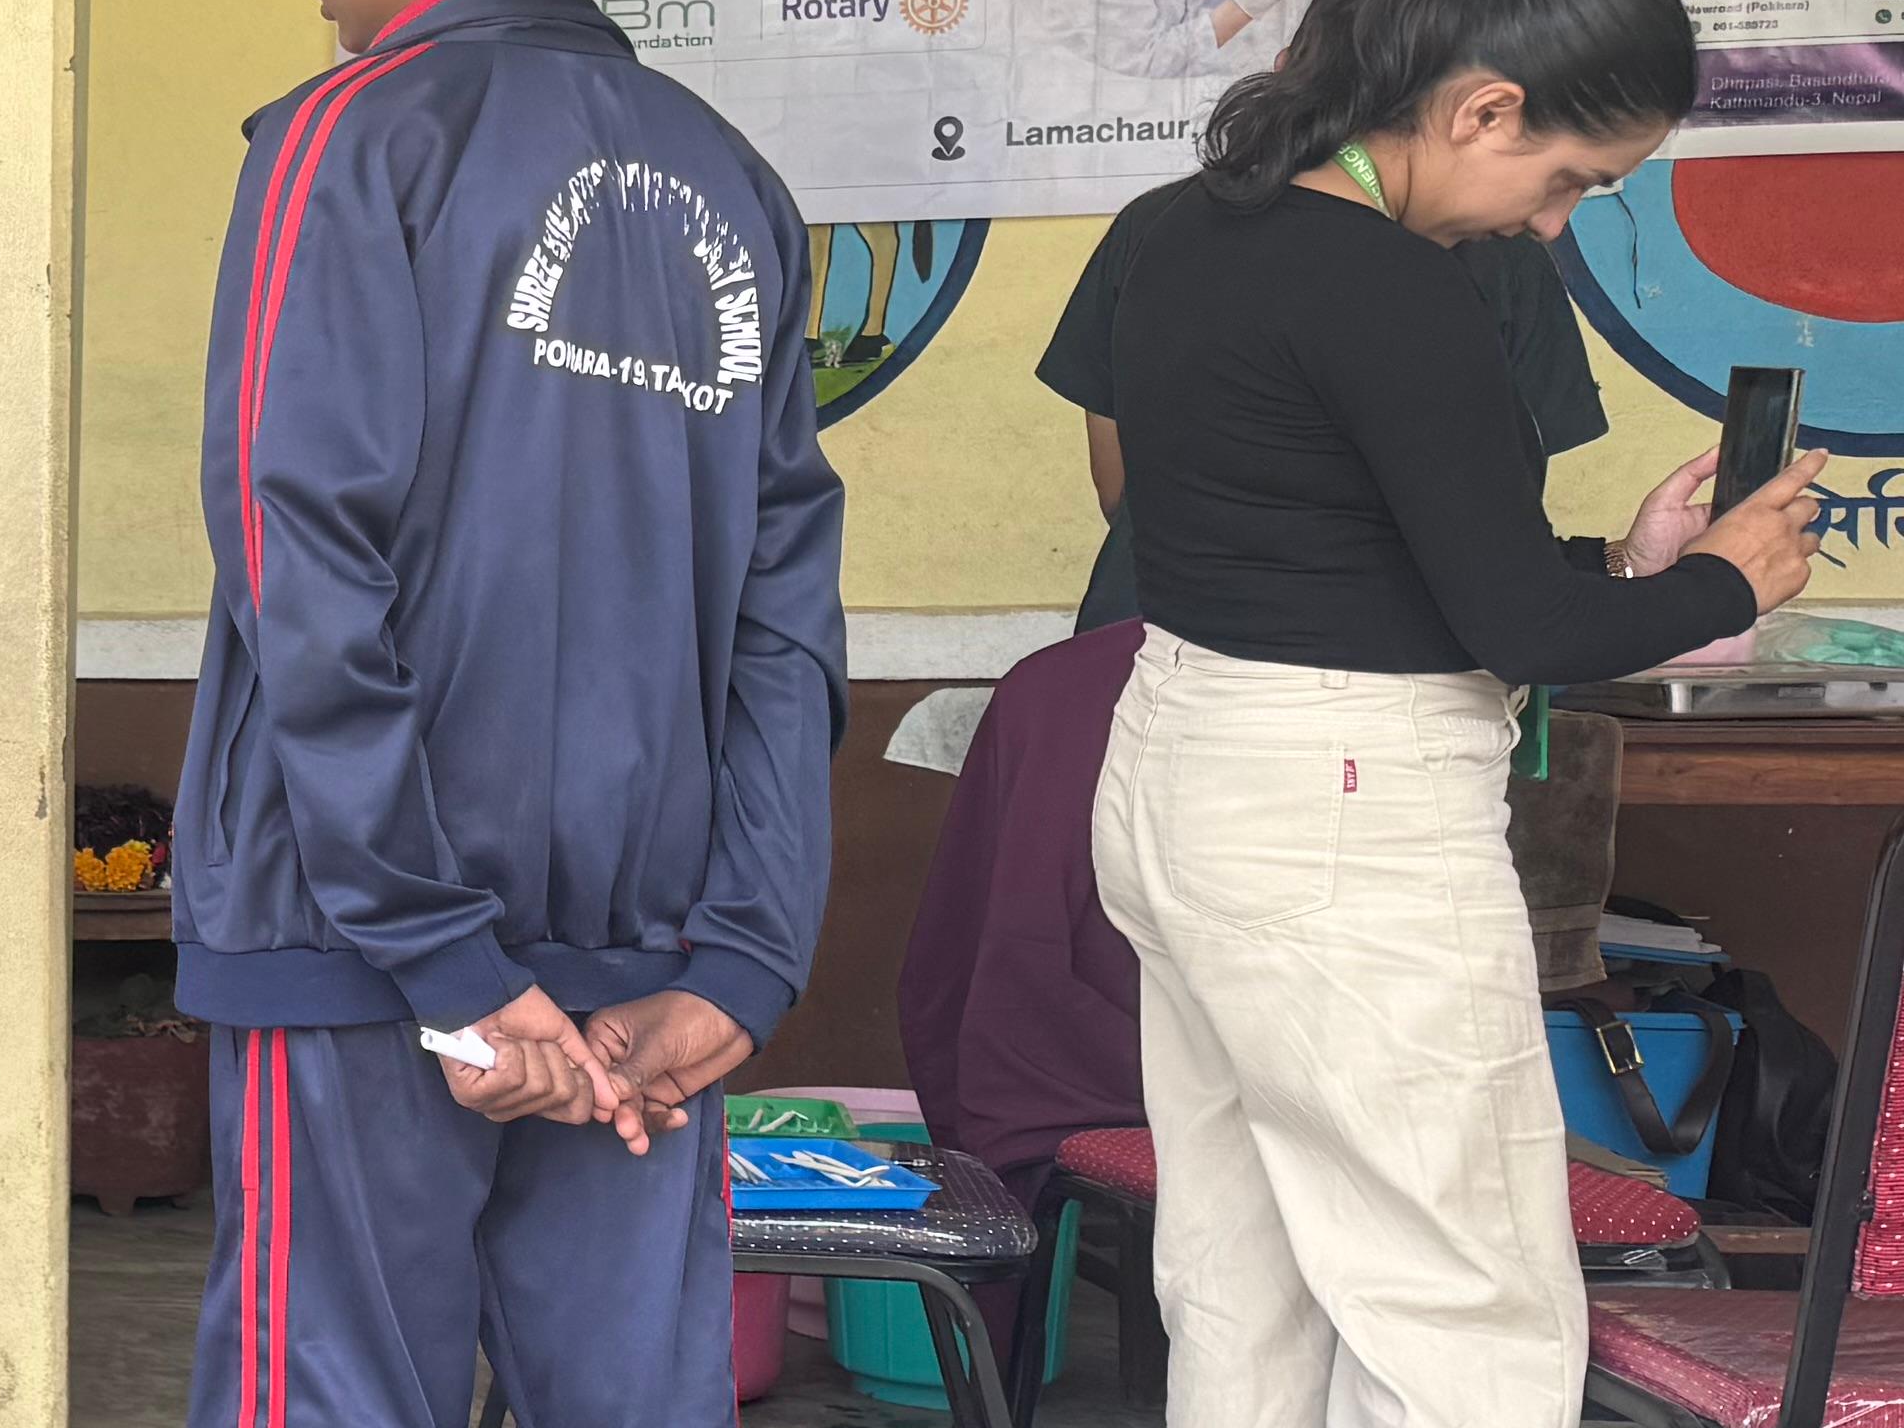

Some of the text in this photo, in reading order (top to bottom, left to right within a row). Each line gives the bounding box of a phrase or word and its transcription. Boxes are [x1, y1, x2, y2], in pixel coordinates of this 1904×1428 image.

[634, 32, 713, 49] ndation
[1832, 90, 1882, 106] Nepal
[1006, 116, 1198, 146] Lamachaur,
[714, 286, 763, 385] SCHOOL
